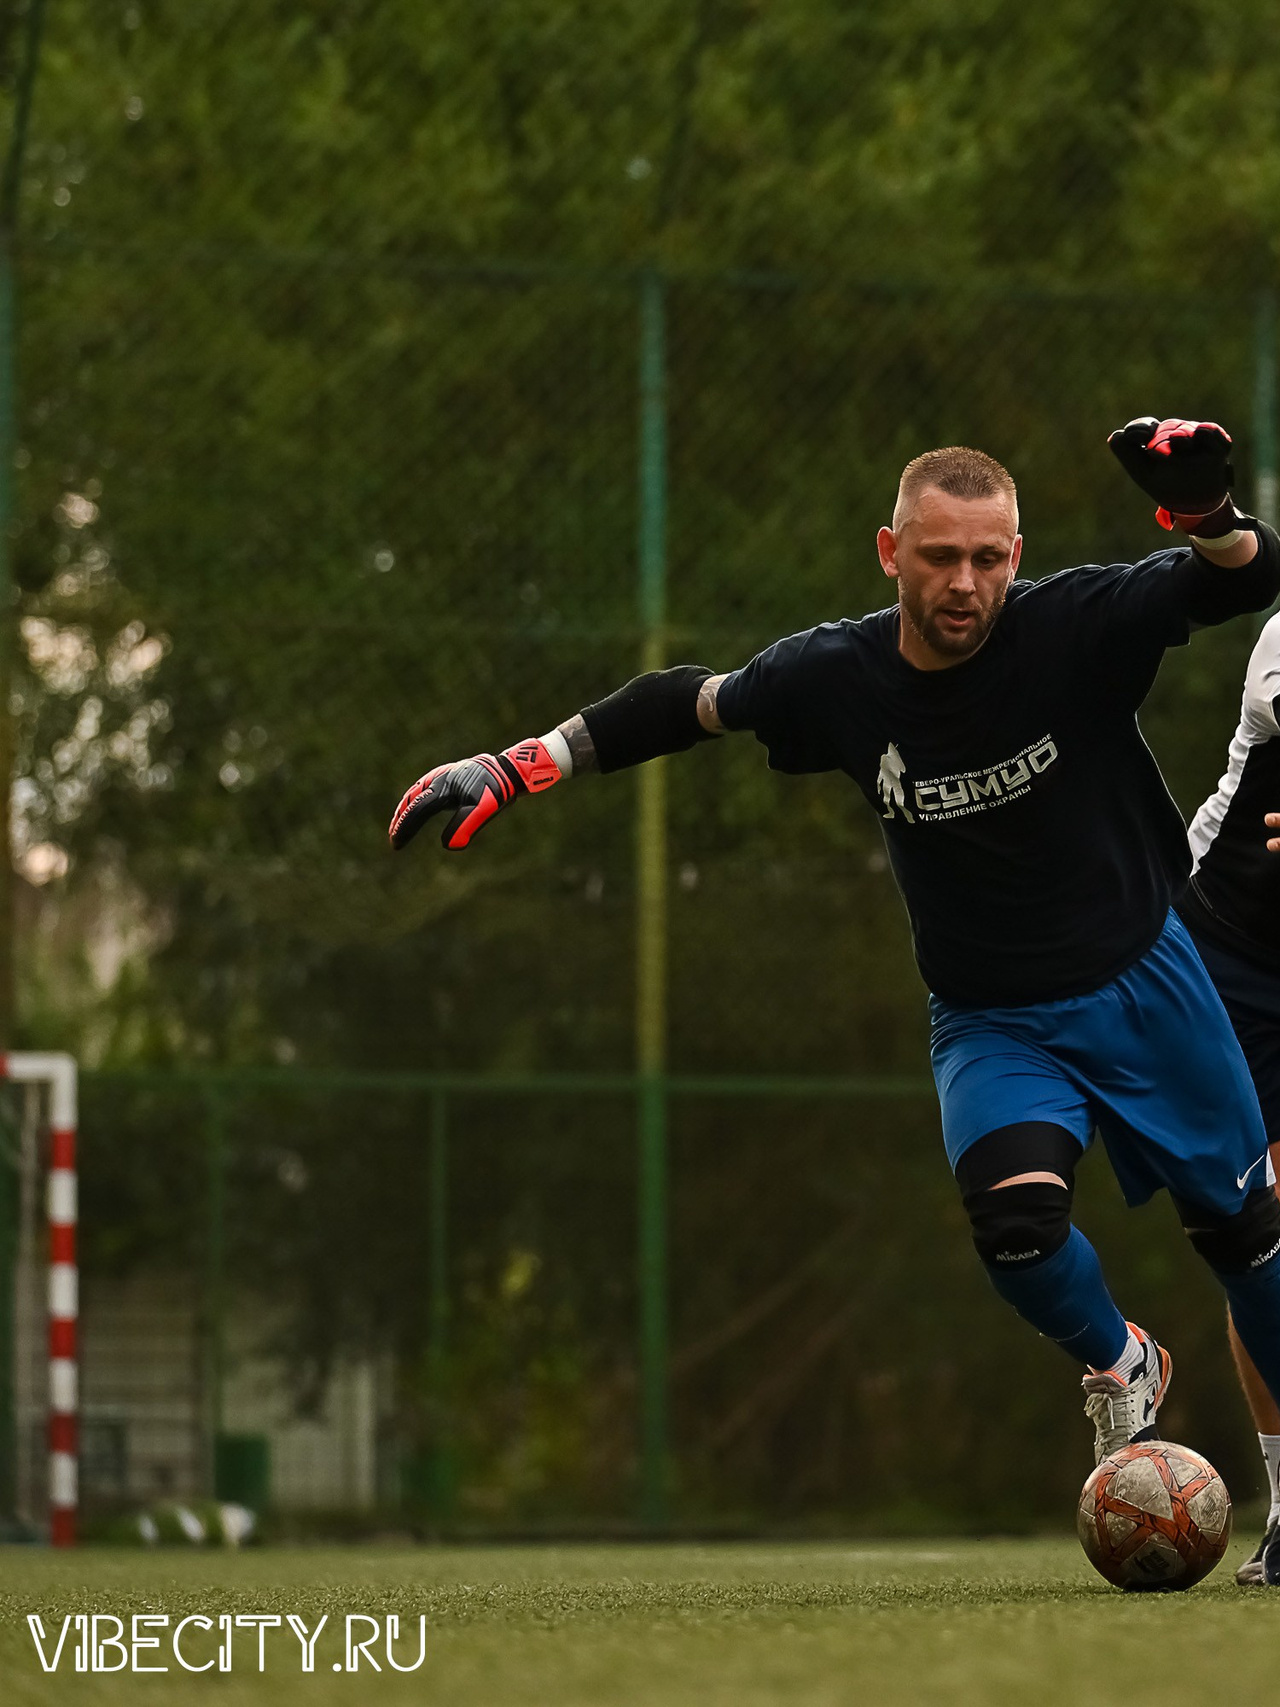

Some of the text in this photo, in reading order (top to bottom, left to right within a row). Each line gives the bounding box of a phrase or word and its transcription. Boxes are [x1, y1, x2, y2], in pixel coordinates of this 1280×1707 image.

[912, 771, 982, 788] ЕВЕРО-УРАЛЬСКОЕ
[915, 741, 1059, 811] СУМУО
[918, 785, 1032, 822] УПРАВЛЕНИЕ ОХРАНЫ
